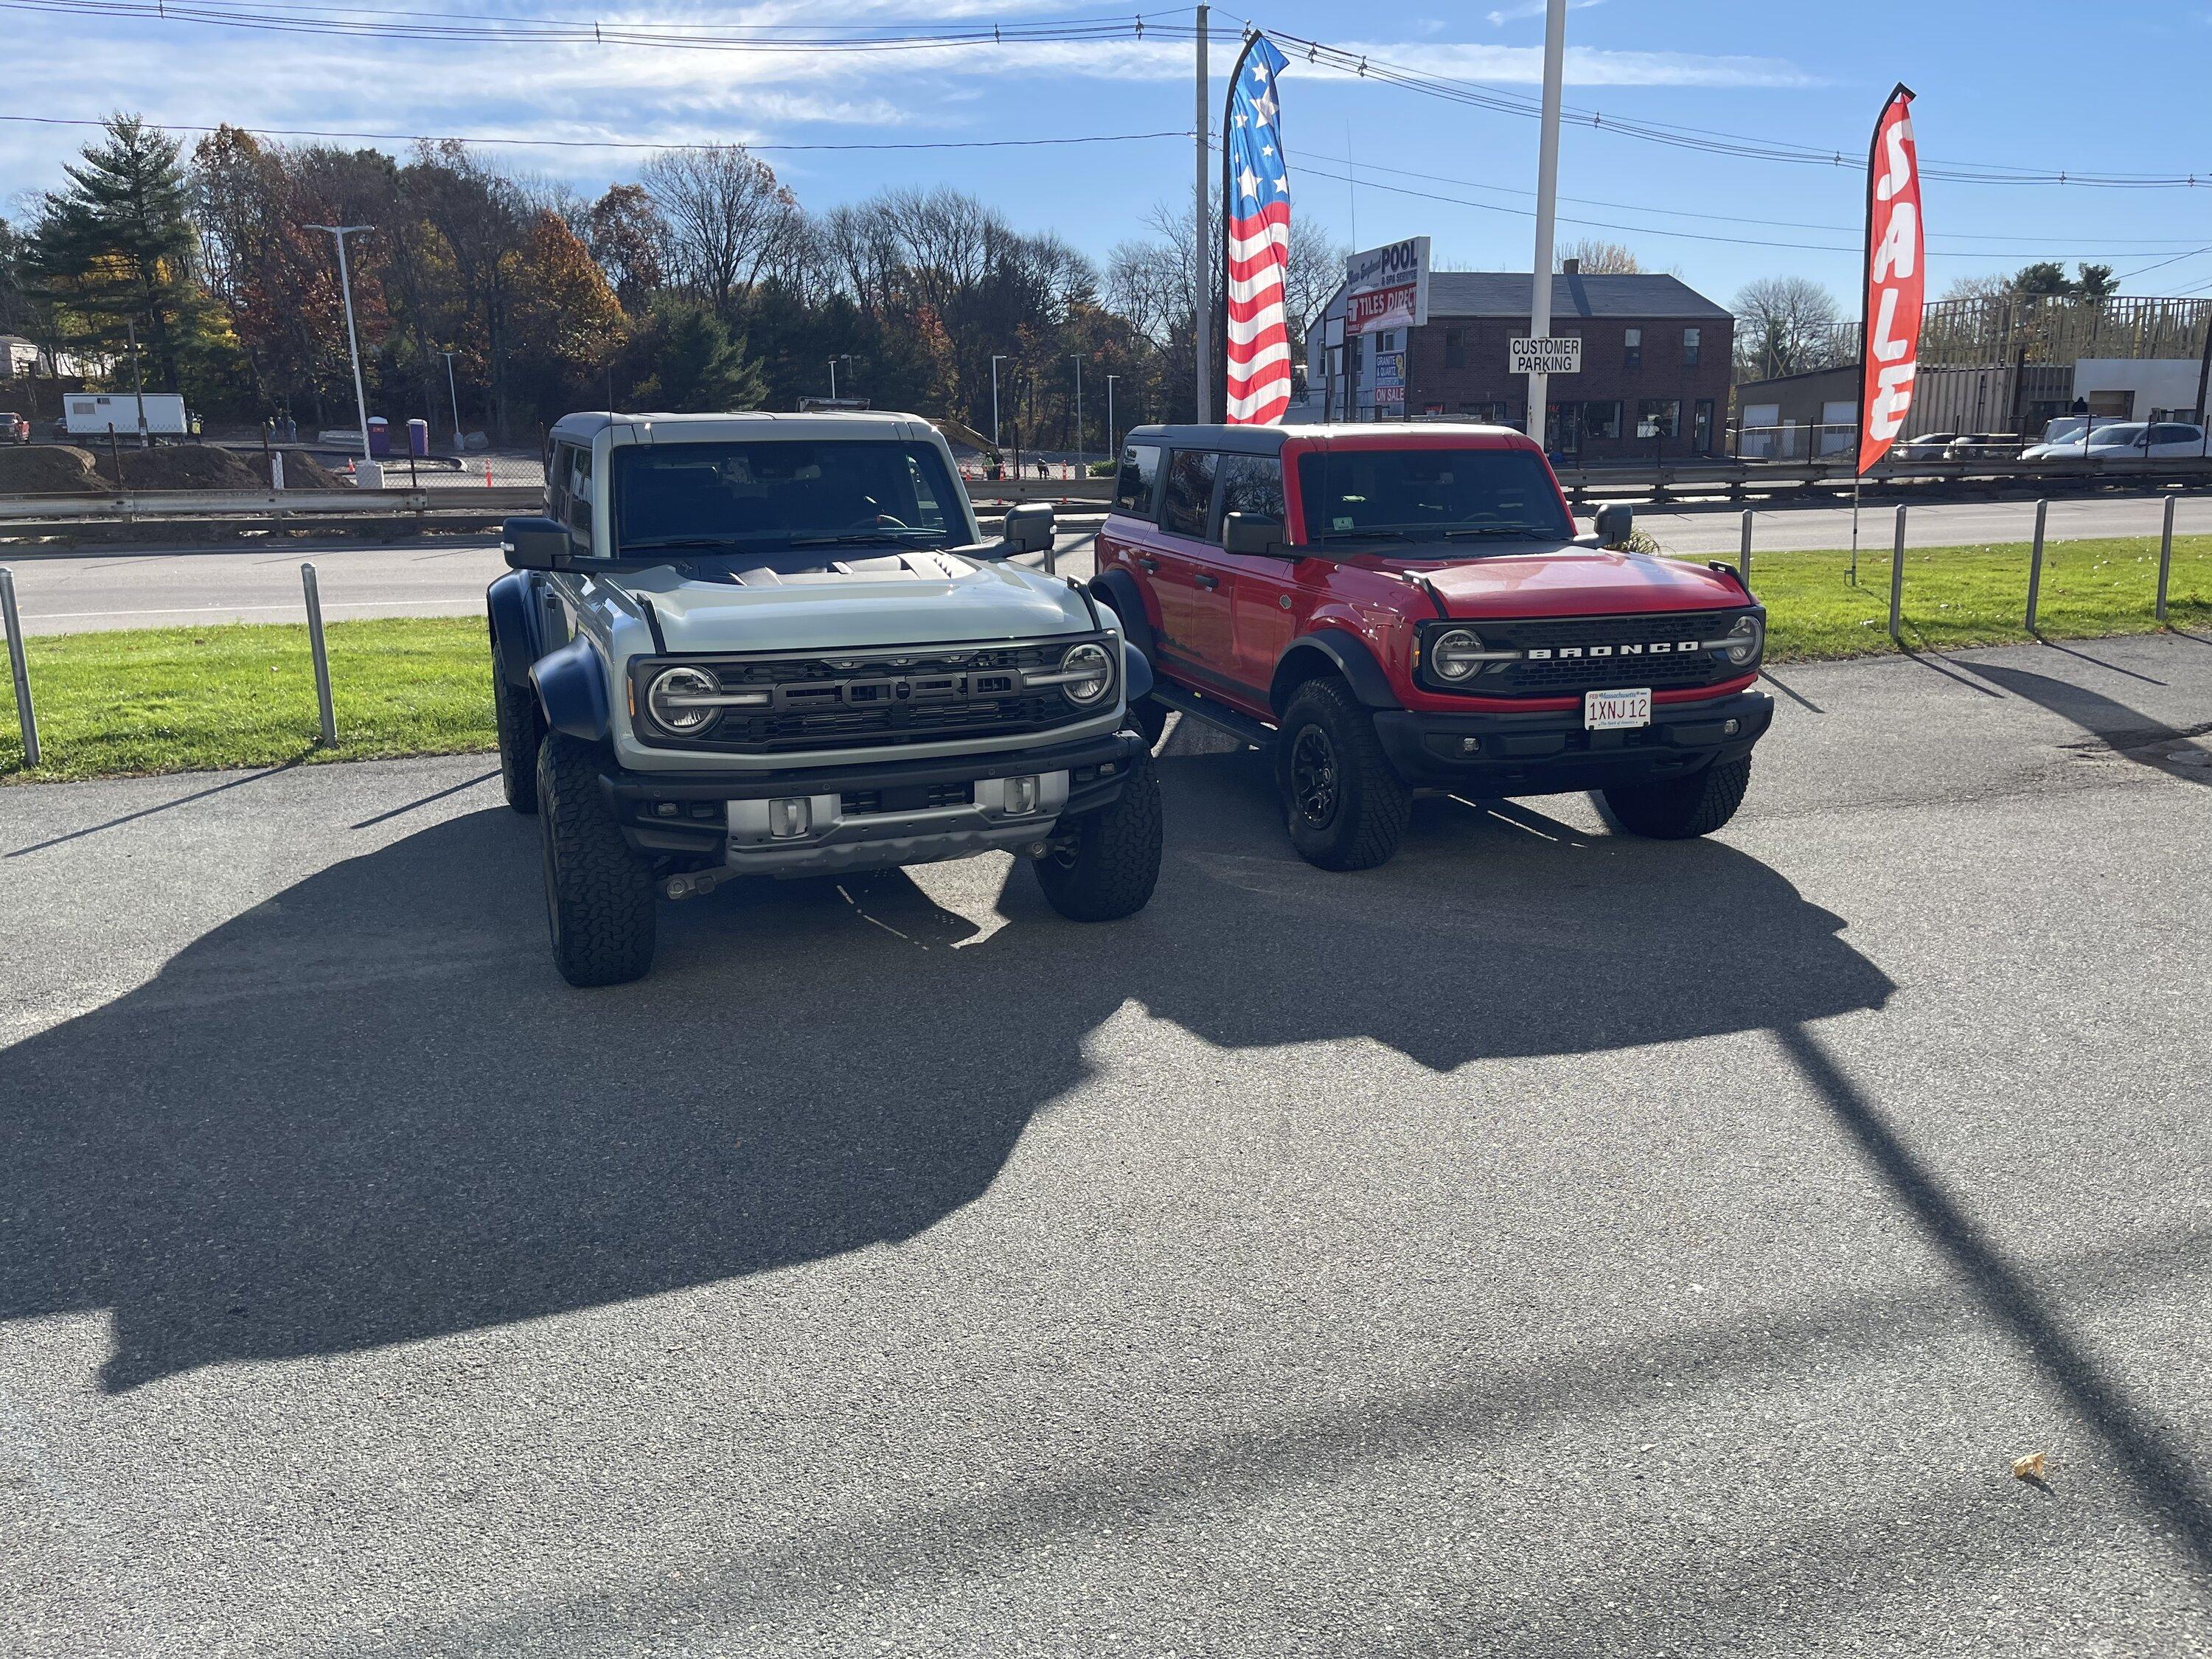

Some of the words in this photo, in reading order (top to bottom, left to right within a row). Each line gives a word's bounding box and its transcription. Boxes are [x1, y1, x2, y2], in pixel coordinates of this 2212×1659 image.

[1381, 240, 1417, 275] POOL
[1386, 274, 1396, 285] SPA
[1397, 269, 1417, 282] SERVICE
[1870, 118, 1917, 442] SALE
[1358, 293, 1385, 316] TILES
[1386, 286, 1416, 312] DIRECT
[1512, 340, 1579, 355] CUSTOMER
[1377, 355, 1396, 366] GRANITE
[1517, 356, 1572, 371] PARKING
[1380, 366, 1397, 377] QUARTZ
[1376, 389, 1386, 402] ON
[1387, 388, 1405, 401] SALE
[1528, 641, 1699, 660] BRONCO
[772, 667, 1022, 714] FORD
[1600, 692, 1636, 700] Massachusetts
